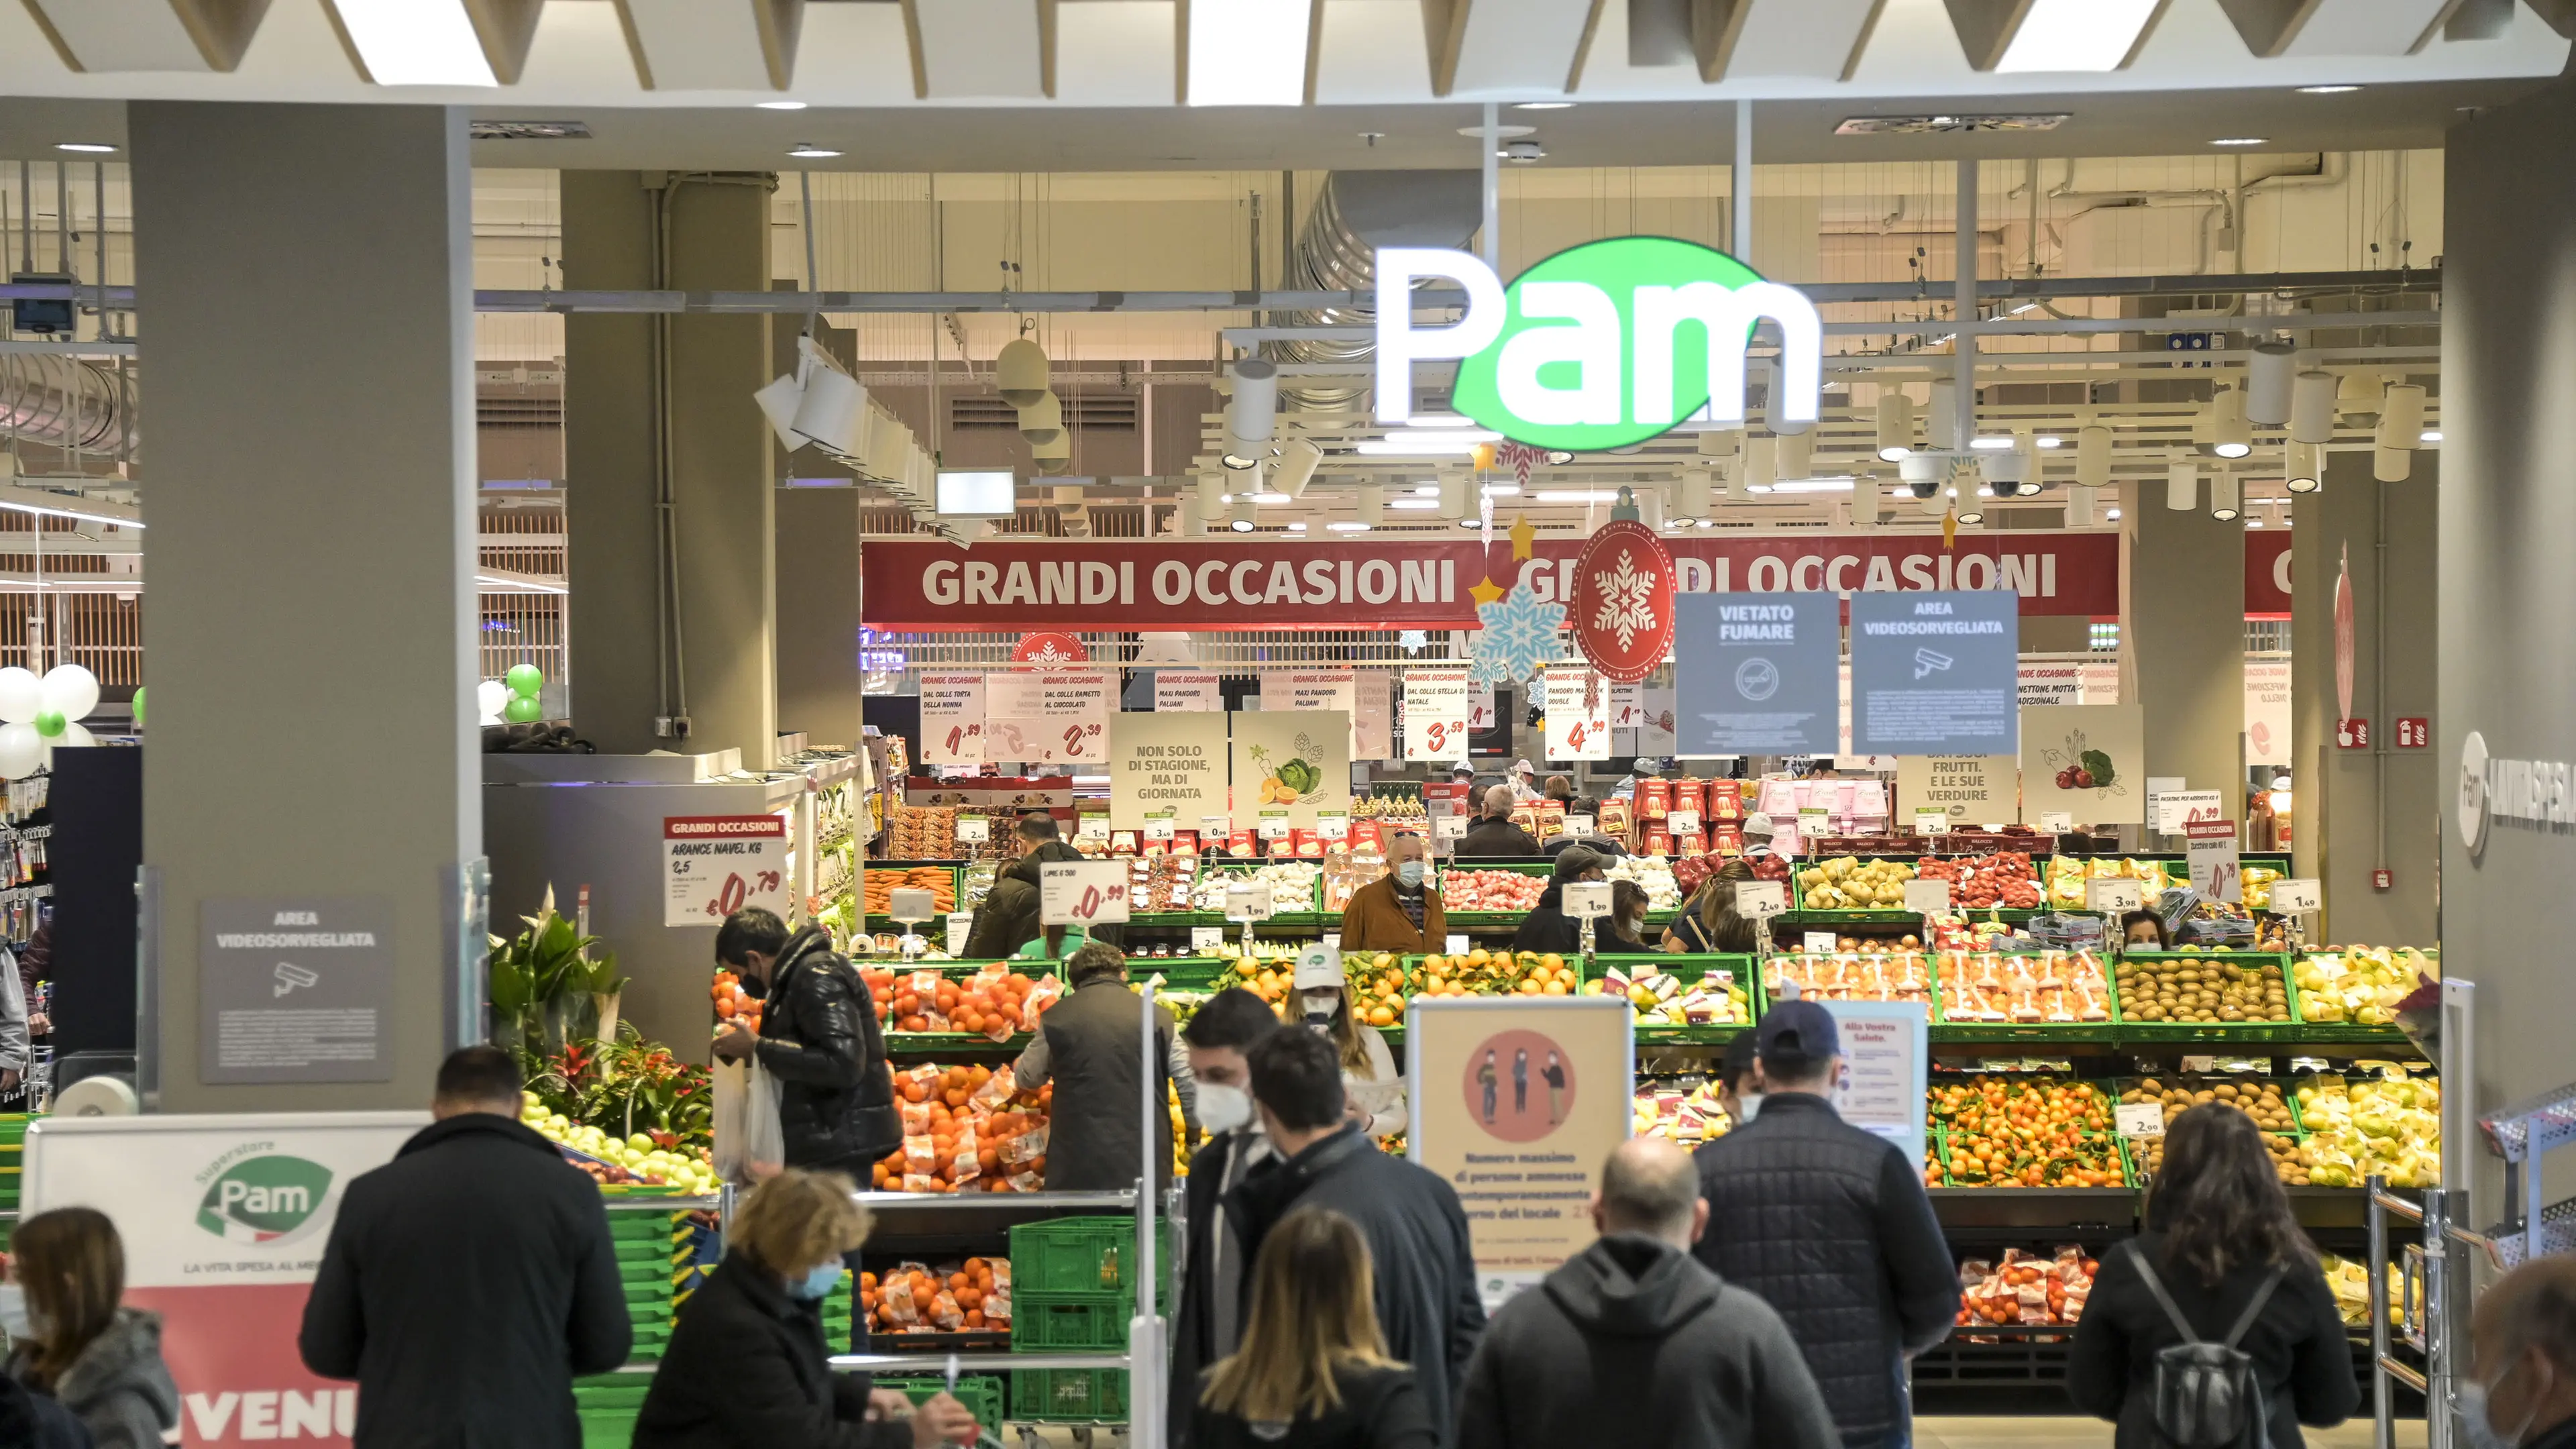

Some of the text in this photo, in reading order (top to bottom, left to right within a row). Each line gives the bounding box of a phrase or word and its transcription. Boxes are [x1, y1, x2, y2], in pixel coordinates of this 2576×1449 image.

[1375, 248, 1823, 425] Pam
[922, 559, 1454, 605] GRANDI OCCASIONI
[1720, 605, 1794, 621] VIETATO
[1915, 602, 1953, 615] AREA
[1721, 624, 1794, 640] FUMARE
[1865, 621, 2004, 635] VIDEOSORVEGLIATA
[1293, 674, 1354, 683] GRANDE OCCASIONE
[2037, 669, 2076, 677] OCCASIONE
[921, 676, 983, 684] GRANDE OCCASIONE
[1069, 676, 1104, 684] OCCASIONE
[1137, 746, 1202, 757] NON SOLO
[1128, 760, 1211, 773] DI STAGIONE,
[1933, 762, 1982, 772] FRUTTI.
[1152, 775, 1187, 785] MA DI
[1931, 775, 1984, 786] E LE SUE
[1138, 788, 1202, 799] GIORNATA
[1927, 790, 1988, 801] VERDURE
[672, 822, 779, 833] GRANDI OCCASIONI
[1450, 827, 1463, 835] 1,89
[1576, 826, 1589, 835] 1,49
[1681, 822, 1694, 830] 2,19
[1811, 826, 1824, 834] 1,95
[1929, 824, 1943, 833] 2,00
[2055, 823, 2068, 831] 1,46
[2190, 826, 2208, 835] GRANDI
[971, 830, 985, 839] 2,49
[1093, 829, 1106, 838] 1,79
[1157, 829, 1171, 838] 3,49
[1212, 828, 1226, 837] 0,99
[1272, 828, 1285, 836] 1,80
[1330, 828, 1344, 836] 1,49
[672, 843, 712, 855] ARANCE
[714, 843, 746, 855] NAVEL
[1588, 900, 1607, 911] 1,99
[1760, 901, 1779, 912] 2,49
[2115, 896, 2136, 907] 3,98
[2295, 896, 2315, 907] 1,49
[1246, 905, 1264, 916] 1,99
[274, 912, 319, 926] AREA
[216, 933, 376, 948] VIDEOSORVEGLIATA
[1205, 939, 1219, 947] 2,99
[1818, 944, 1831, 953] 1,29
[1845, 1022, 1896, 1032] Alla Vostra
[2137, 1121, 2158, 1132] 2,99
[195, 1140, 275, 1185] Superstore
[1466, 1152, 1576, 1163] Numero massimo
[1470, 1173, 1523, 1185] persone
[1526, 1173, 1587, 1182] ammesse
[220, 1180, 309, 1214] Pam
[1458, 1191, 1591, 1203] ontemporaneamente
[1499, 1208, 1561, 1219] del locale
[183, 1261, 294, 1273] LA VITA SPESA AL
